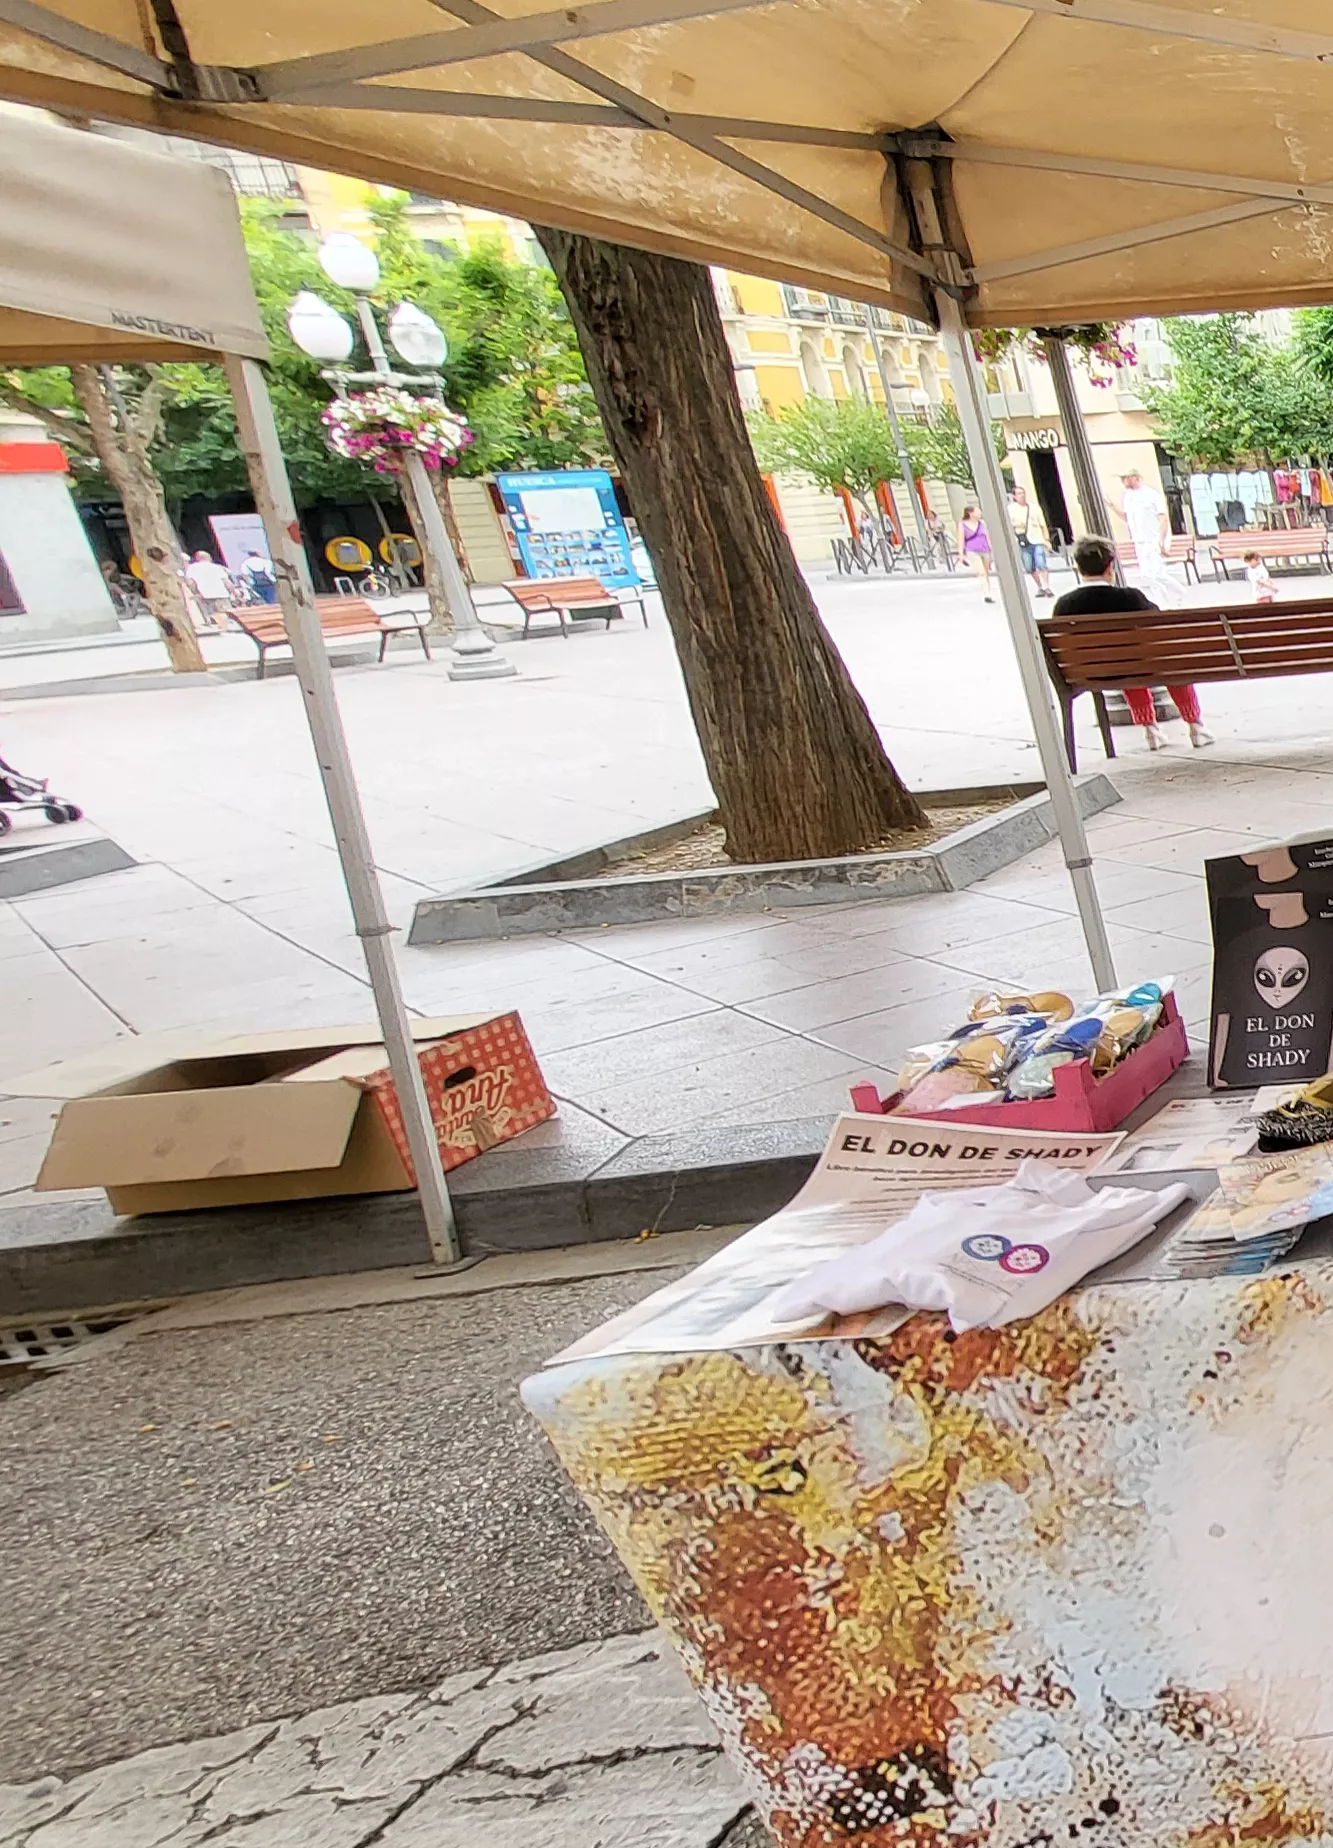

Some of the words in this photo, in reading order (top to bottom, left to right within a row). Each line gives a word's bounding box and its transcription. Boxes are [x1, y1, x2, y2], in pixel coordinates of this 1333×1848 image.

[110, 311, 216, 345] MASTERTENT
[1012, 428, 1058, 450] MANGO
[1246, 1016, 1269, 1033] EL
[1275, 1013, 1315, 1030] DON
[1269, 1033, 1291, 1048] DE
[1246, 1048, 1311, 1069] SHADY
[448, 1069, 510, 1117] Ana
[841, 1134, 877, 1154] EL
[887, 1139, 952, 1160] DON
[957, 1147, 999, 1160] DE
[1004, 1145, 1103, 1160] SHADY
